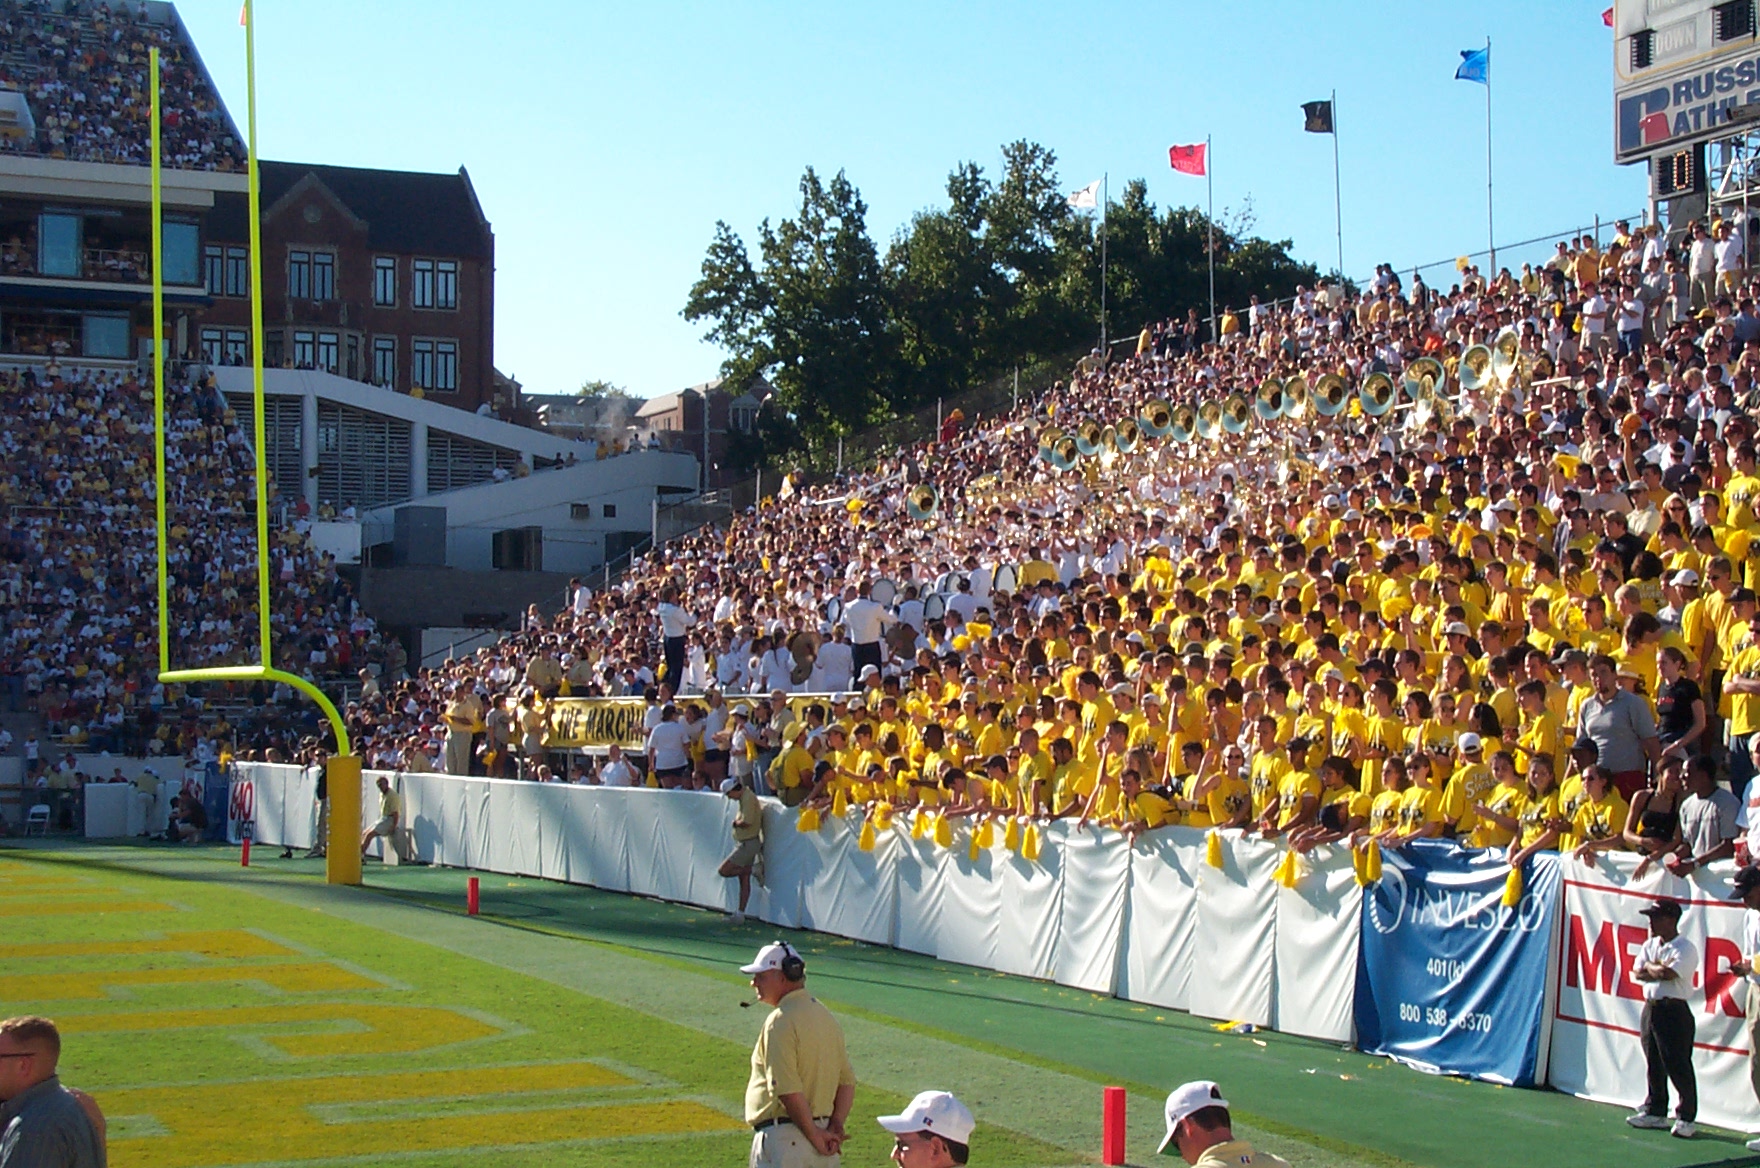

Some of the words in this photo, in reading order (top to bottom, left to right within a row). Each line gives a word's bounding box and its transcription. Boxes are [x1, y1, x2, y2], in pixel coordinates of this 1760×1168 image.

[1655, 25, 1695, 56] DOWN
[1673, 58, 1760, 107] RUSS
[1410, 887, 1545, 932] INVESCO
[1400, 1002, 1421, 1023] 800
